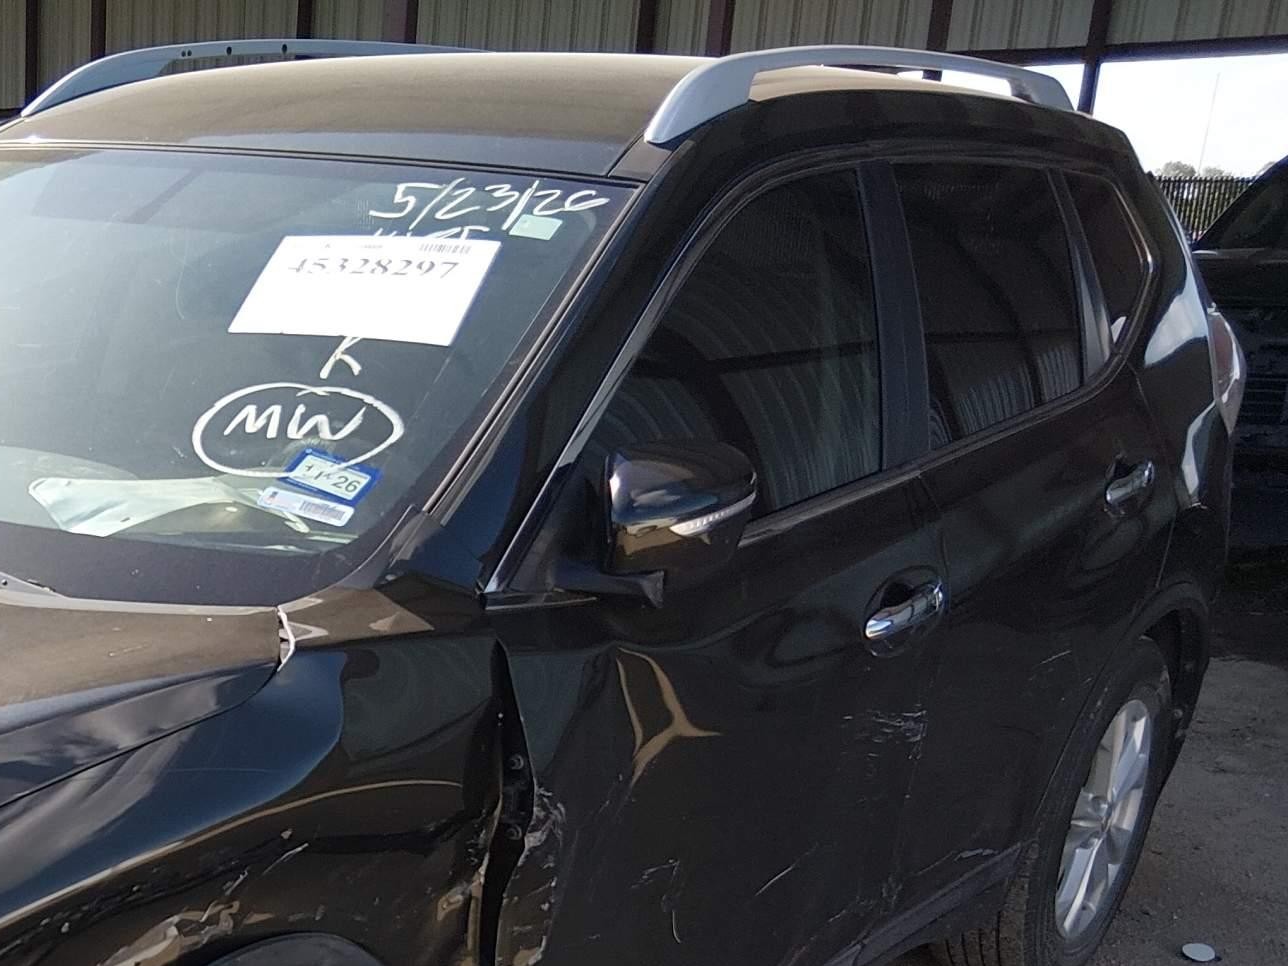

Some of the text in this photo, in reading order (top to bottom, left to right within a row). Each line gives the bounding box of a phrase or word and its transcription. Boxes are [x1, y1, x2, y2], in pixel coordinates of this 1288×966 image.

[288, 258, 460, 278] 45328297
[223, 403, 367, 441] MW
[331, 475, 361, 493] 26
